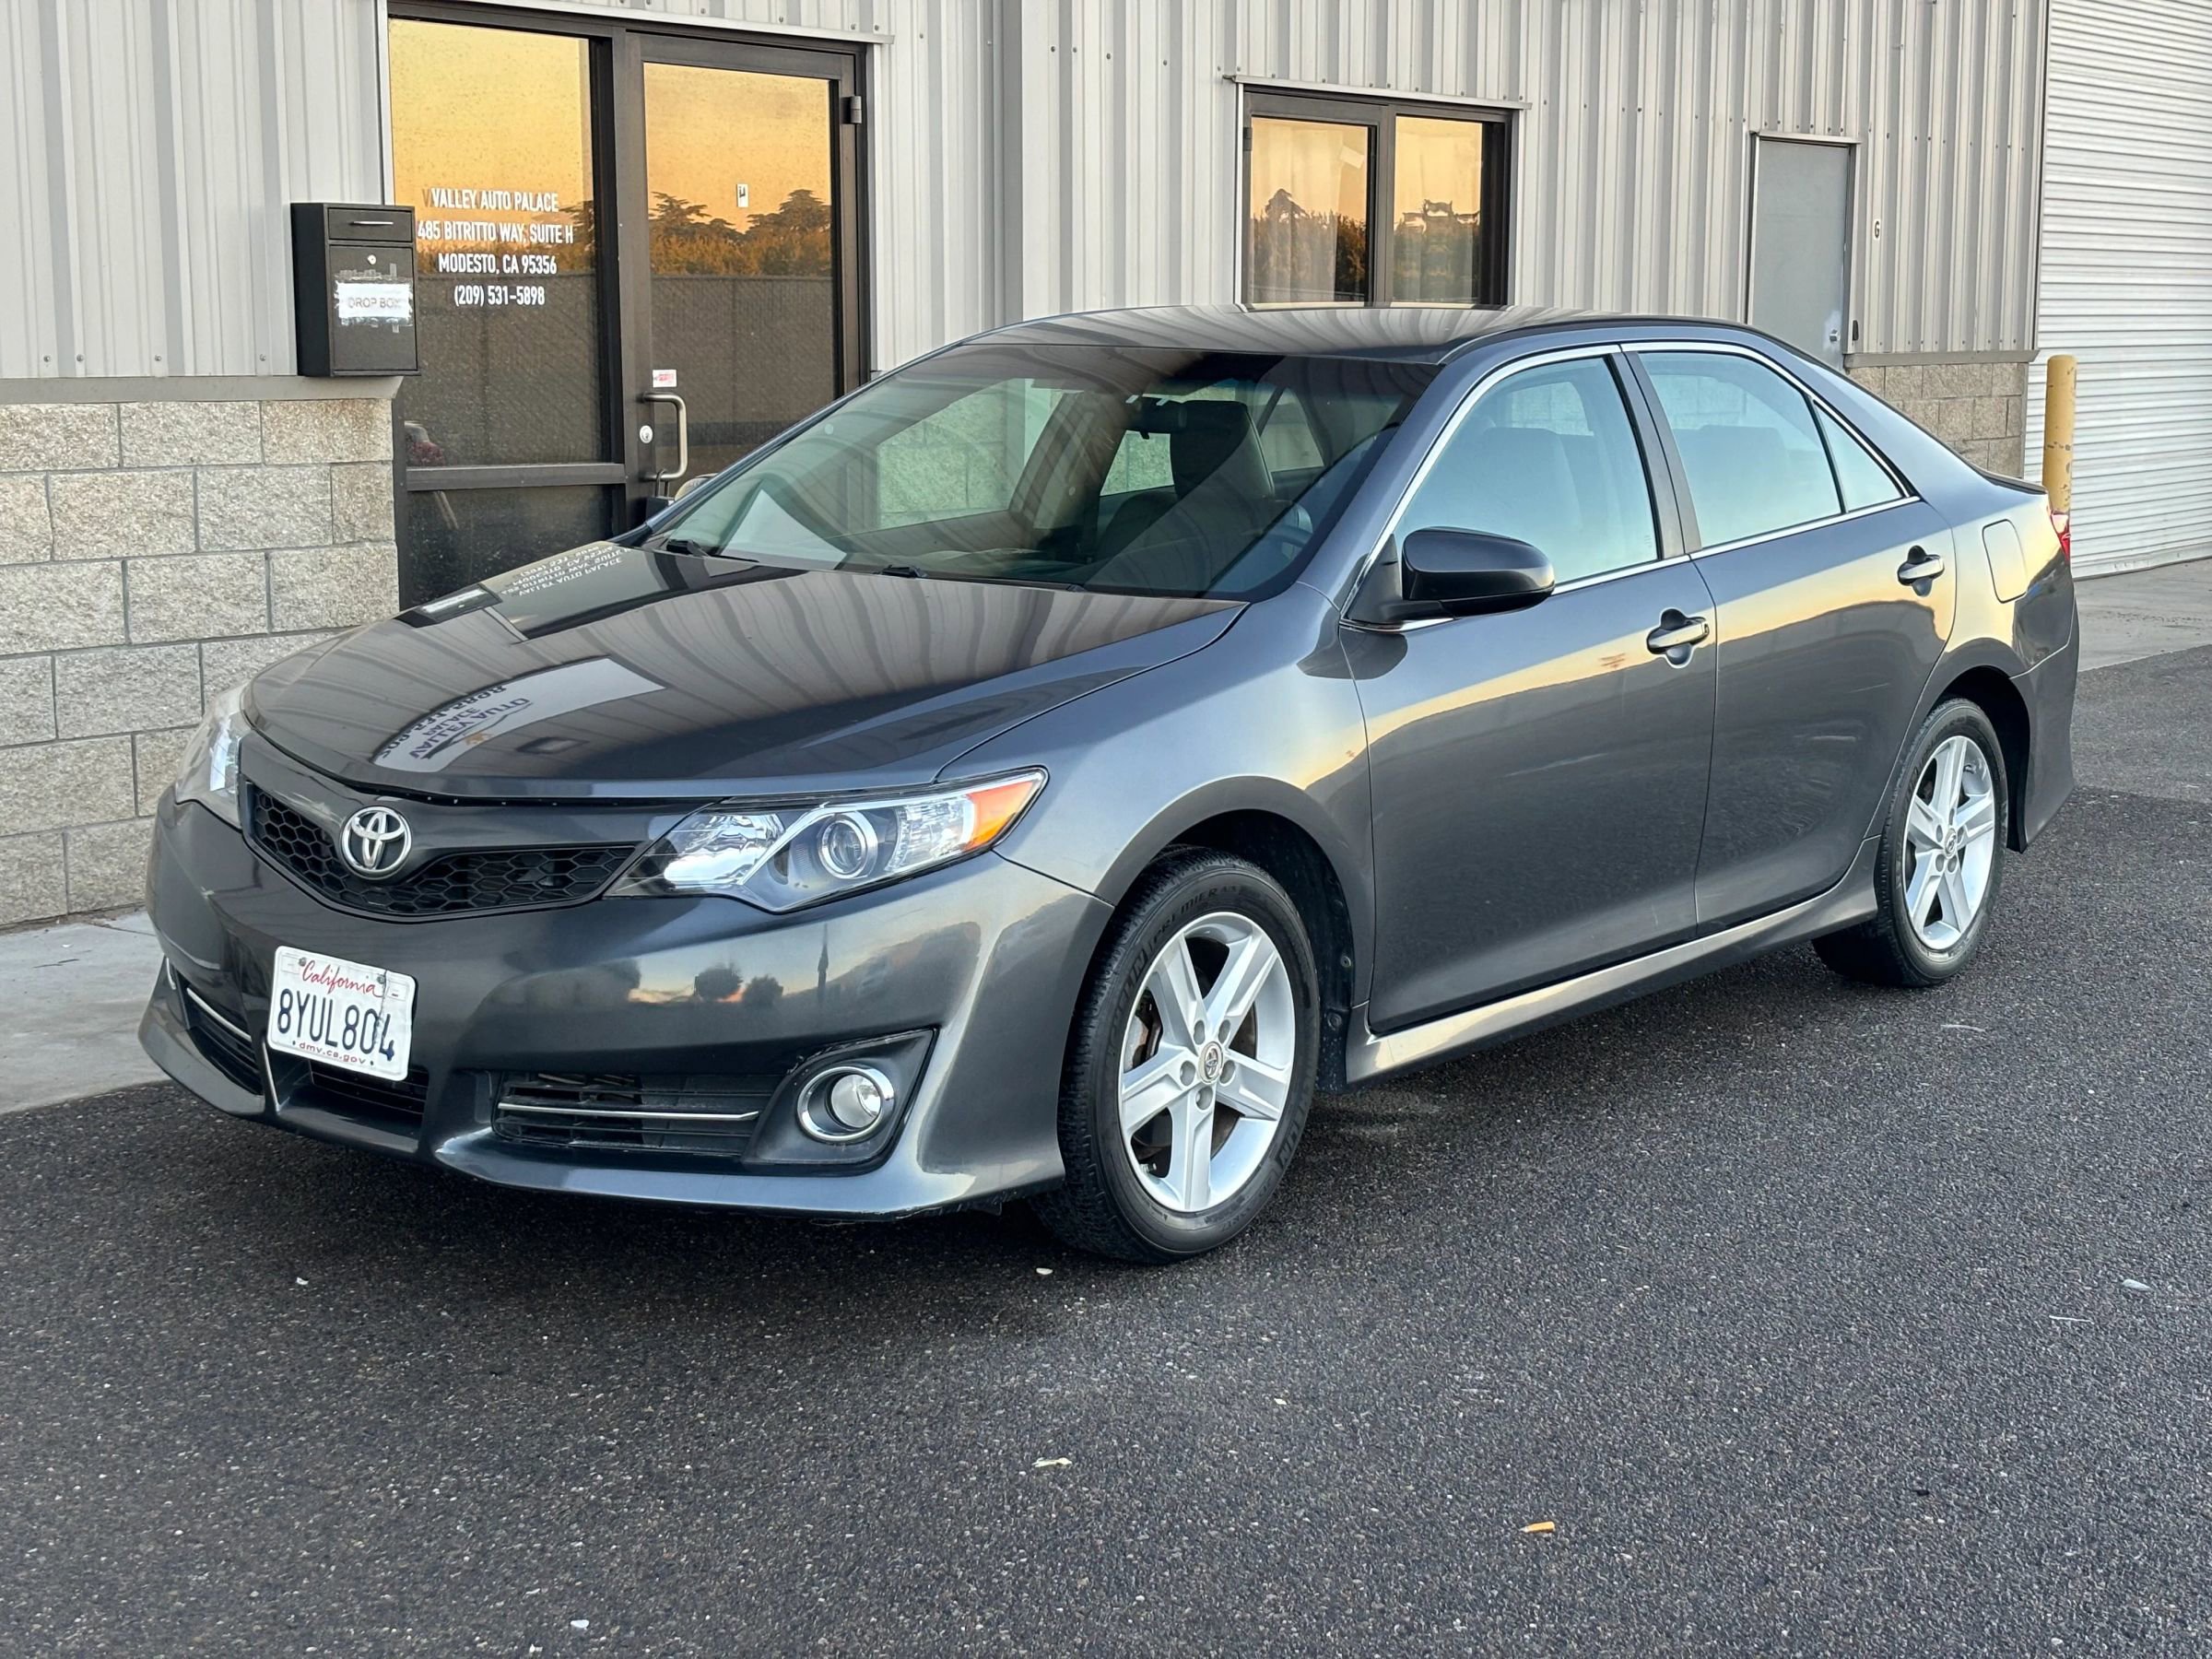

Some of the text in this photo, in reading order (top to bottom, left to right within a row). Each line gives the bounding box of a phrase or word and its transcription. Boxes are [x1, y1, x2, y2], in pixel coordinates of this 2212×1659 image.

[431, 188, 559, 212] VALLEY AUTO PALACE
[418, 220, 573, 243] 485 BITRITTO WAY, SUITE H
[439, 253, 557, 275] MODESTO, CA 95356
[347, 297, 377, 309] DROP
[454, 285, 545, 307] (209) 531-5898
[302, 959, 385, 998] California
[277, 988, 395, 1061] 8YUL804
[299, 1041, 367, 1065] dmv.ca.gov
